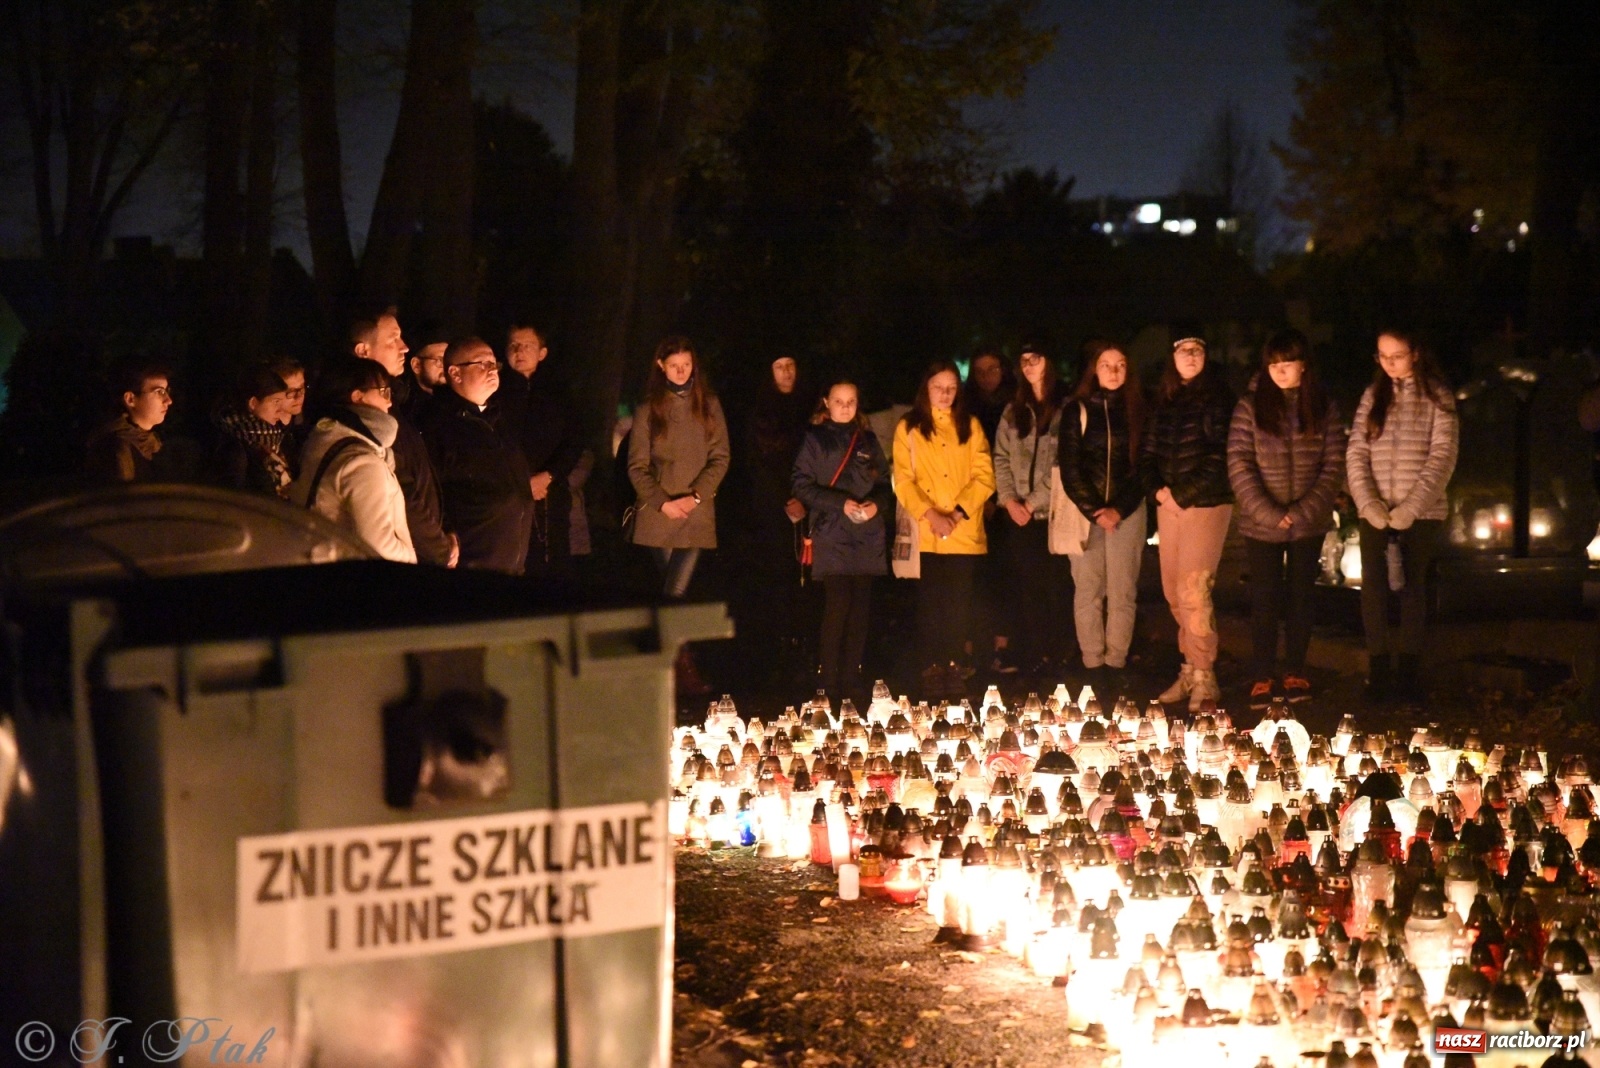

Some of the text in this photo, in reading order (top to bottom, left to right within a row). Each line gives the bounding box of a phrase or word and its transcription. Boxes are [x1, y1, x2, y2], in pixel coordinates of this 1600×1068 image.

[255, 815, 654, 903] ZNICZE SZKLANE
[327, 906, 339, 951] I
[356, 896, 455, 948] INNE
